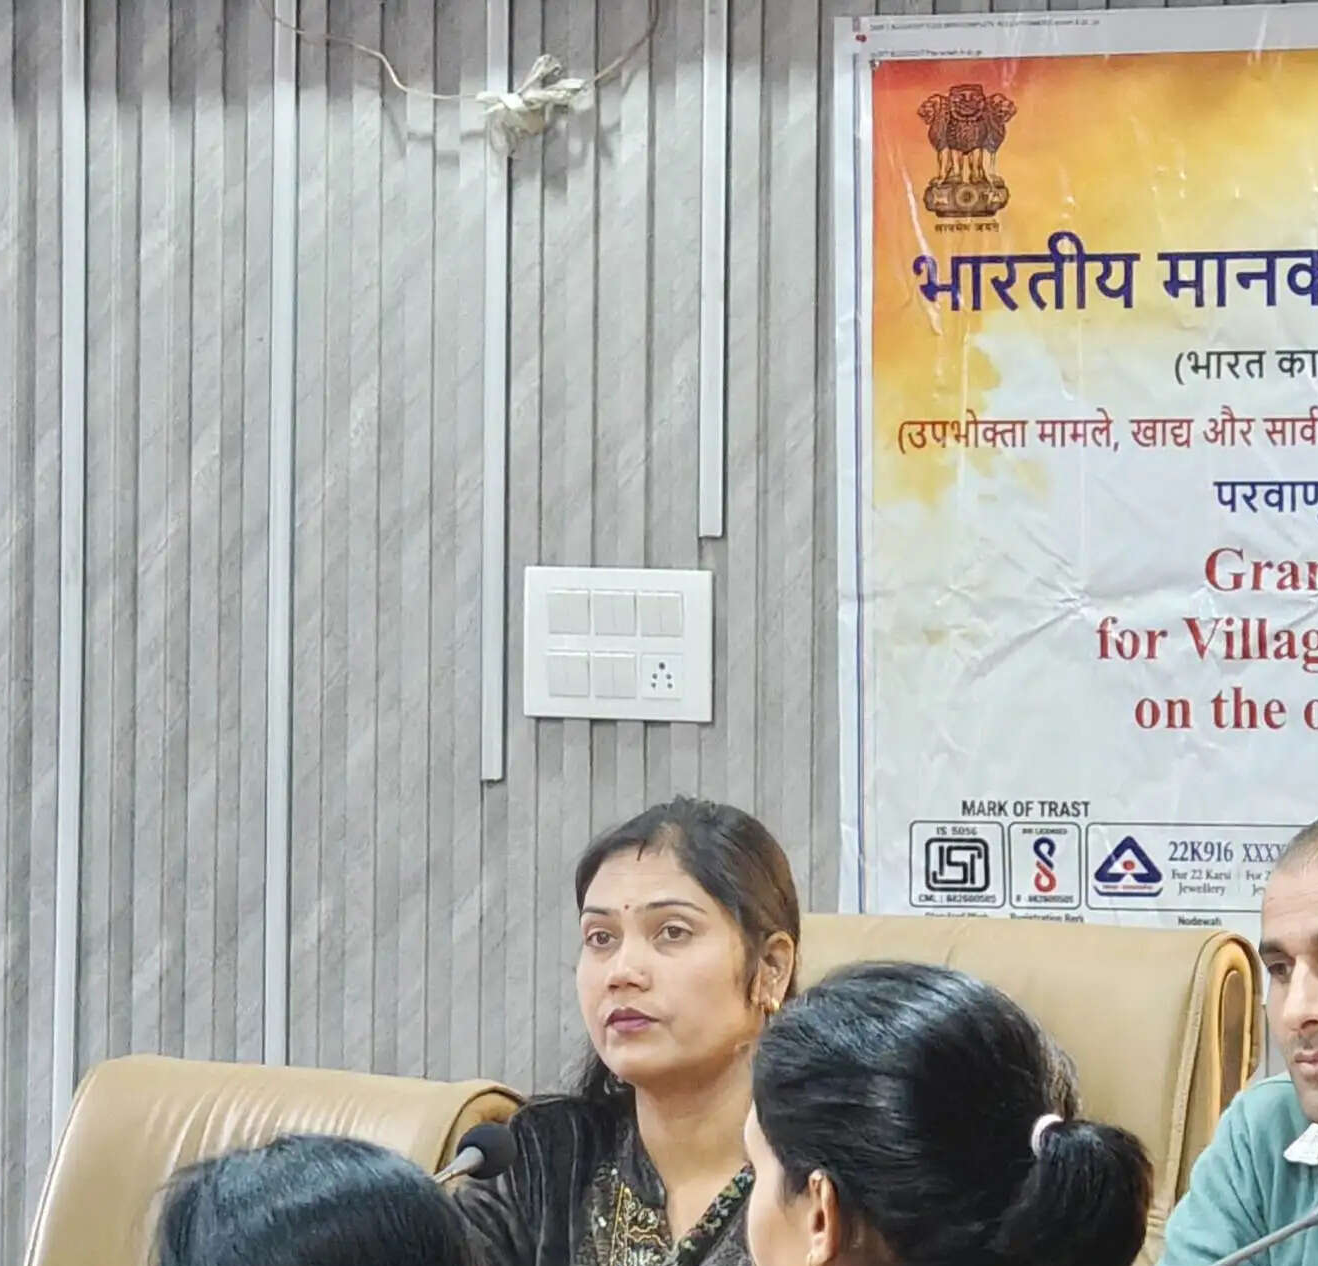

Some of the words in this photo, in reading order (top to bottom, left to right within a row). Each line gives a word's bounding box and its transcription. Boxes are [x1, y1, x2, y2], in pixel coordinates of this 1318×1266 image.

[913, 231, 1140, 311] भारतीय
[1175, 351, 1266, 385] (भारत
[1276, 349, 1318, 378] का
[897, 409, 1027, 452] (उपभोक्ता
[1036, 408, 1120, 452] मामले,
[1130, 418, 1194, 449] खाद्य
[1203, 405, 1254, 447] और
[1097, 616, 1168, 661] for
[1135, 698, 1193, 730] on
[1211, 687, 1286, 731] the
[962, 801, 1008, 817] MARK
[1013, 801, 1034, 817] OF
[1039, 801, 1090, 818] TRAST
[1168, 841, 1234, 862] 22K916
